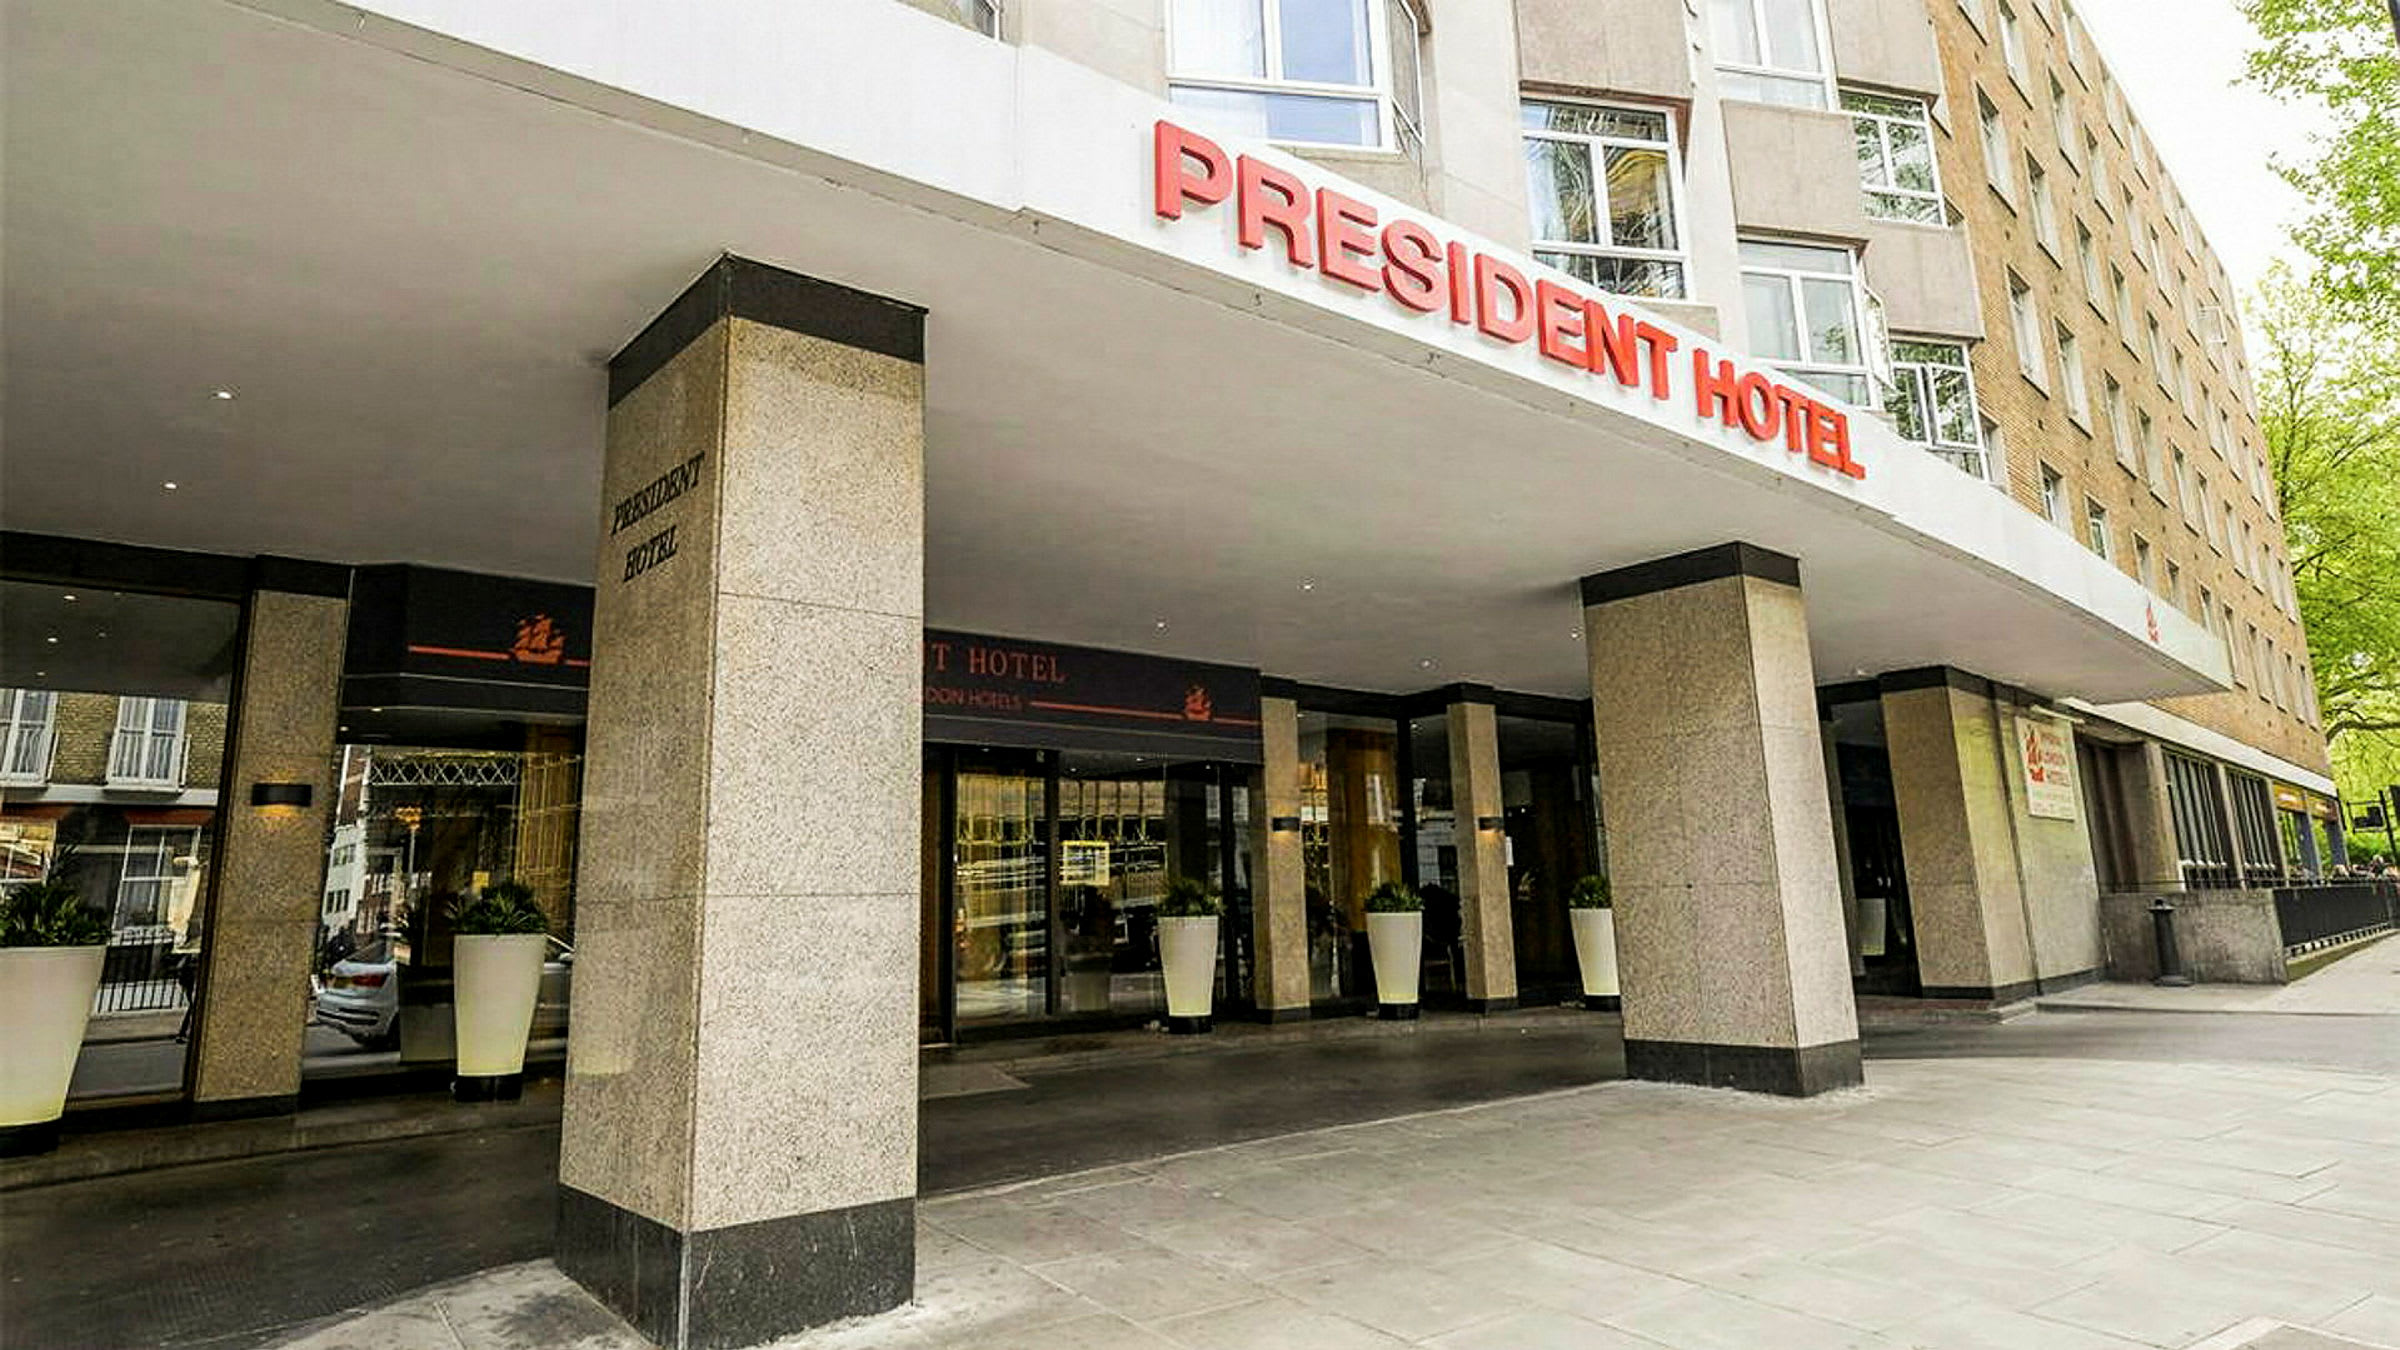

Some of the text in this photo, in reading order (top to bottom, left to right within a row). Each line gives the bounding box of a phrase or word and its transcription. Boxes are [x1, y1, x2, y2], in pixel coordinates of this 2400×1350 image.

[1154, 119, 1866, 480] PRESIDENT HOTEL
[610, 450, 705, 536] PRESIDENT
[623, 524, 678, 582] HOTEL
[968, 646, 1069, 684] HOTEL
